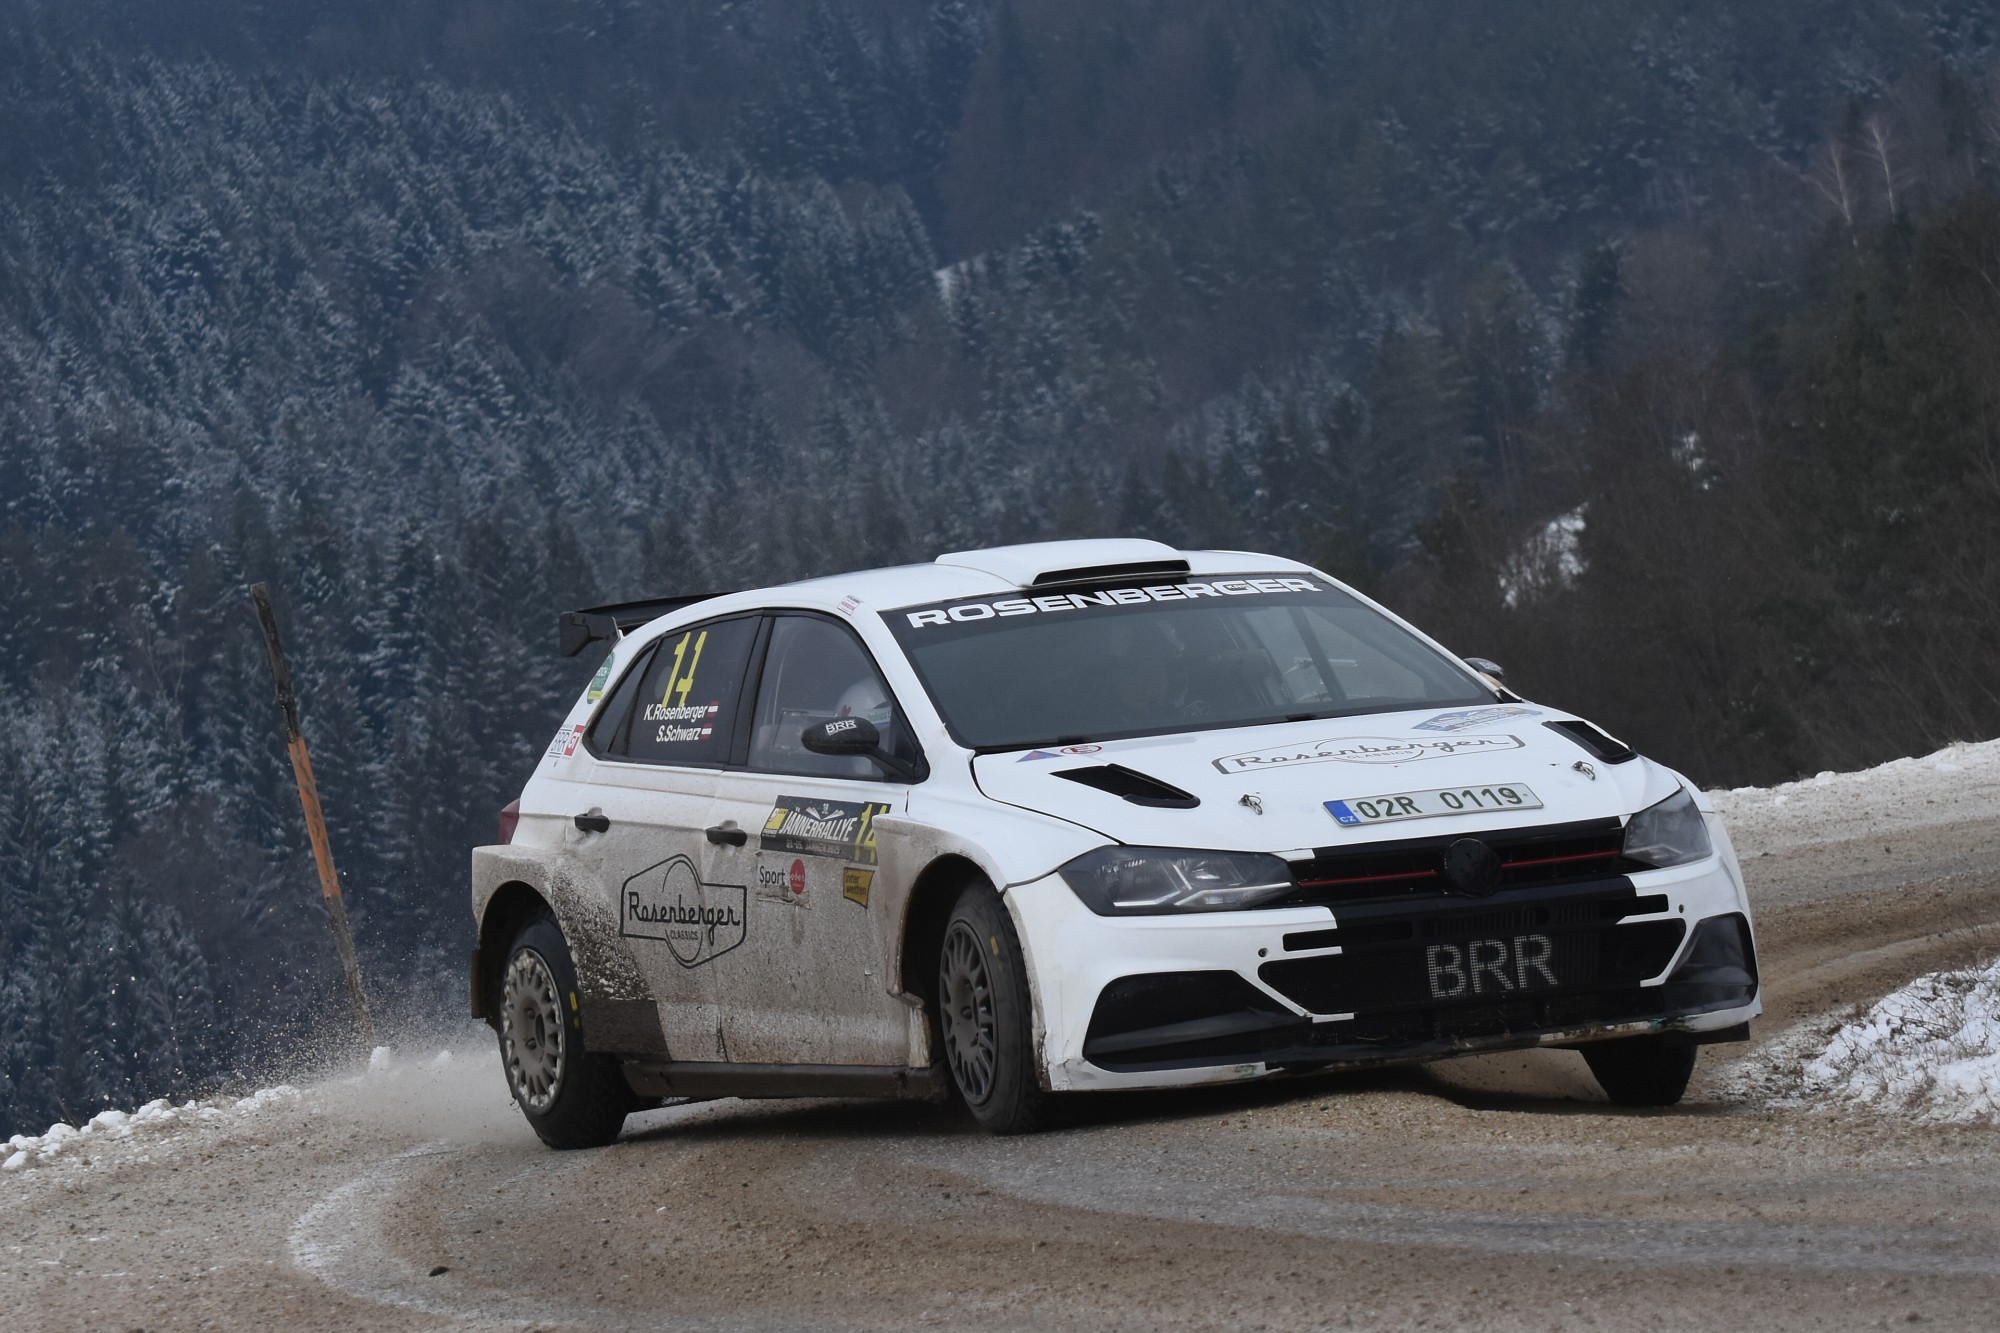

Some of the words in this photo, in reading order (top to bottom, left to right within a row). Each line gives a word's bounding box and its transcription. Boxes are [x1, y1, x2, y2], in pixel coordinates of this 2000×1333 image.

[906, 578, 1322, 628] ROSENBERGER
[643, 703, 709, 723] K.Rosenberger
[656, 725, 702, 742] S.Schwarz
[825, 719, 857, 736] BRR
[1231, 739, 1510, 767] Rosenberger
[1346, 750, 1414, 760] CLASSICS
[1355, 796, 1423, 819] 02R
[1439, 787, 1524, 811] 0119
[1339, 815, 1357, 823] CZ
[759, 865, 785, 888] Sport
[628, 891, 741, 947] Rosenberger
[670, 930, 699, 940] CLASSICS
[1427, 935, 1558, 998] BRR
